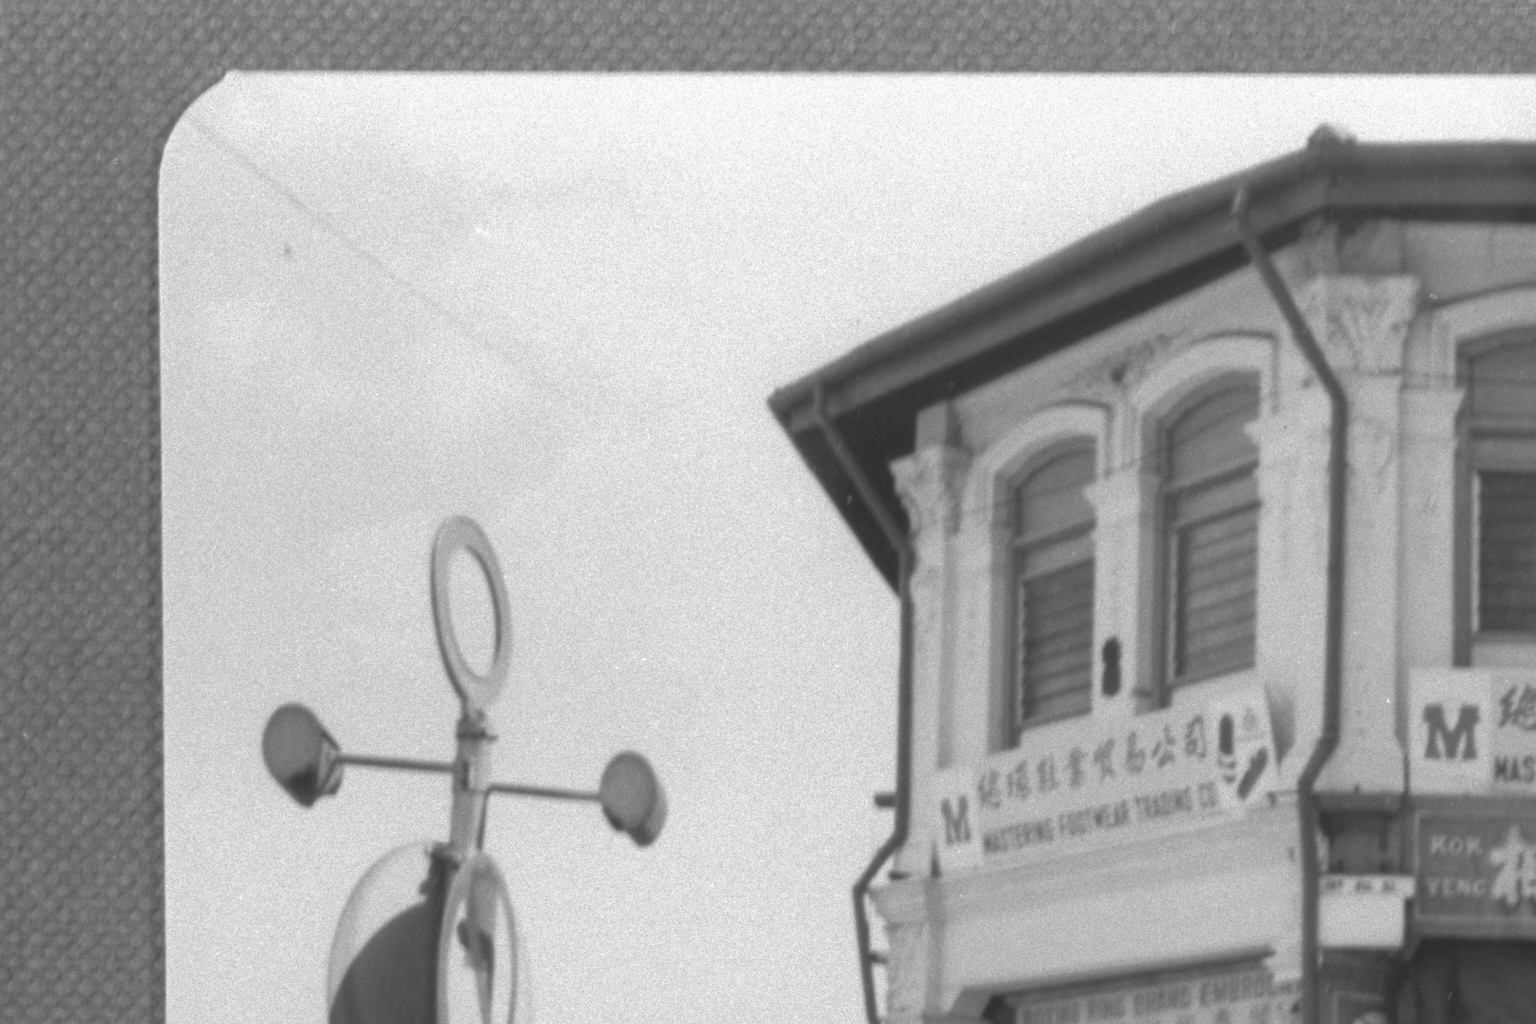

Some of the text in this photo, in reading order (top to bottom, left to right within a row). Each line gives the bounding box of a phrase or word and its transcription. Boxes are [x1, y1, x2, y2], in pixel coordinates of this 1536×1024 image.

[1423, 703, 1480, 760] M
[983, 817, 1054, 854] MASTERING
[1058, 799, 1131, 836] FOOTWEAR
[1135, 785, 1193, 818] TRADING
